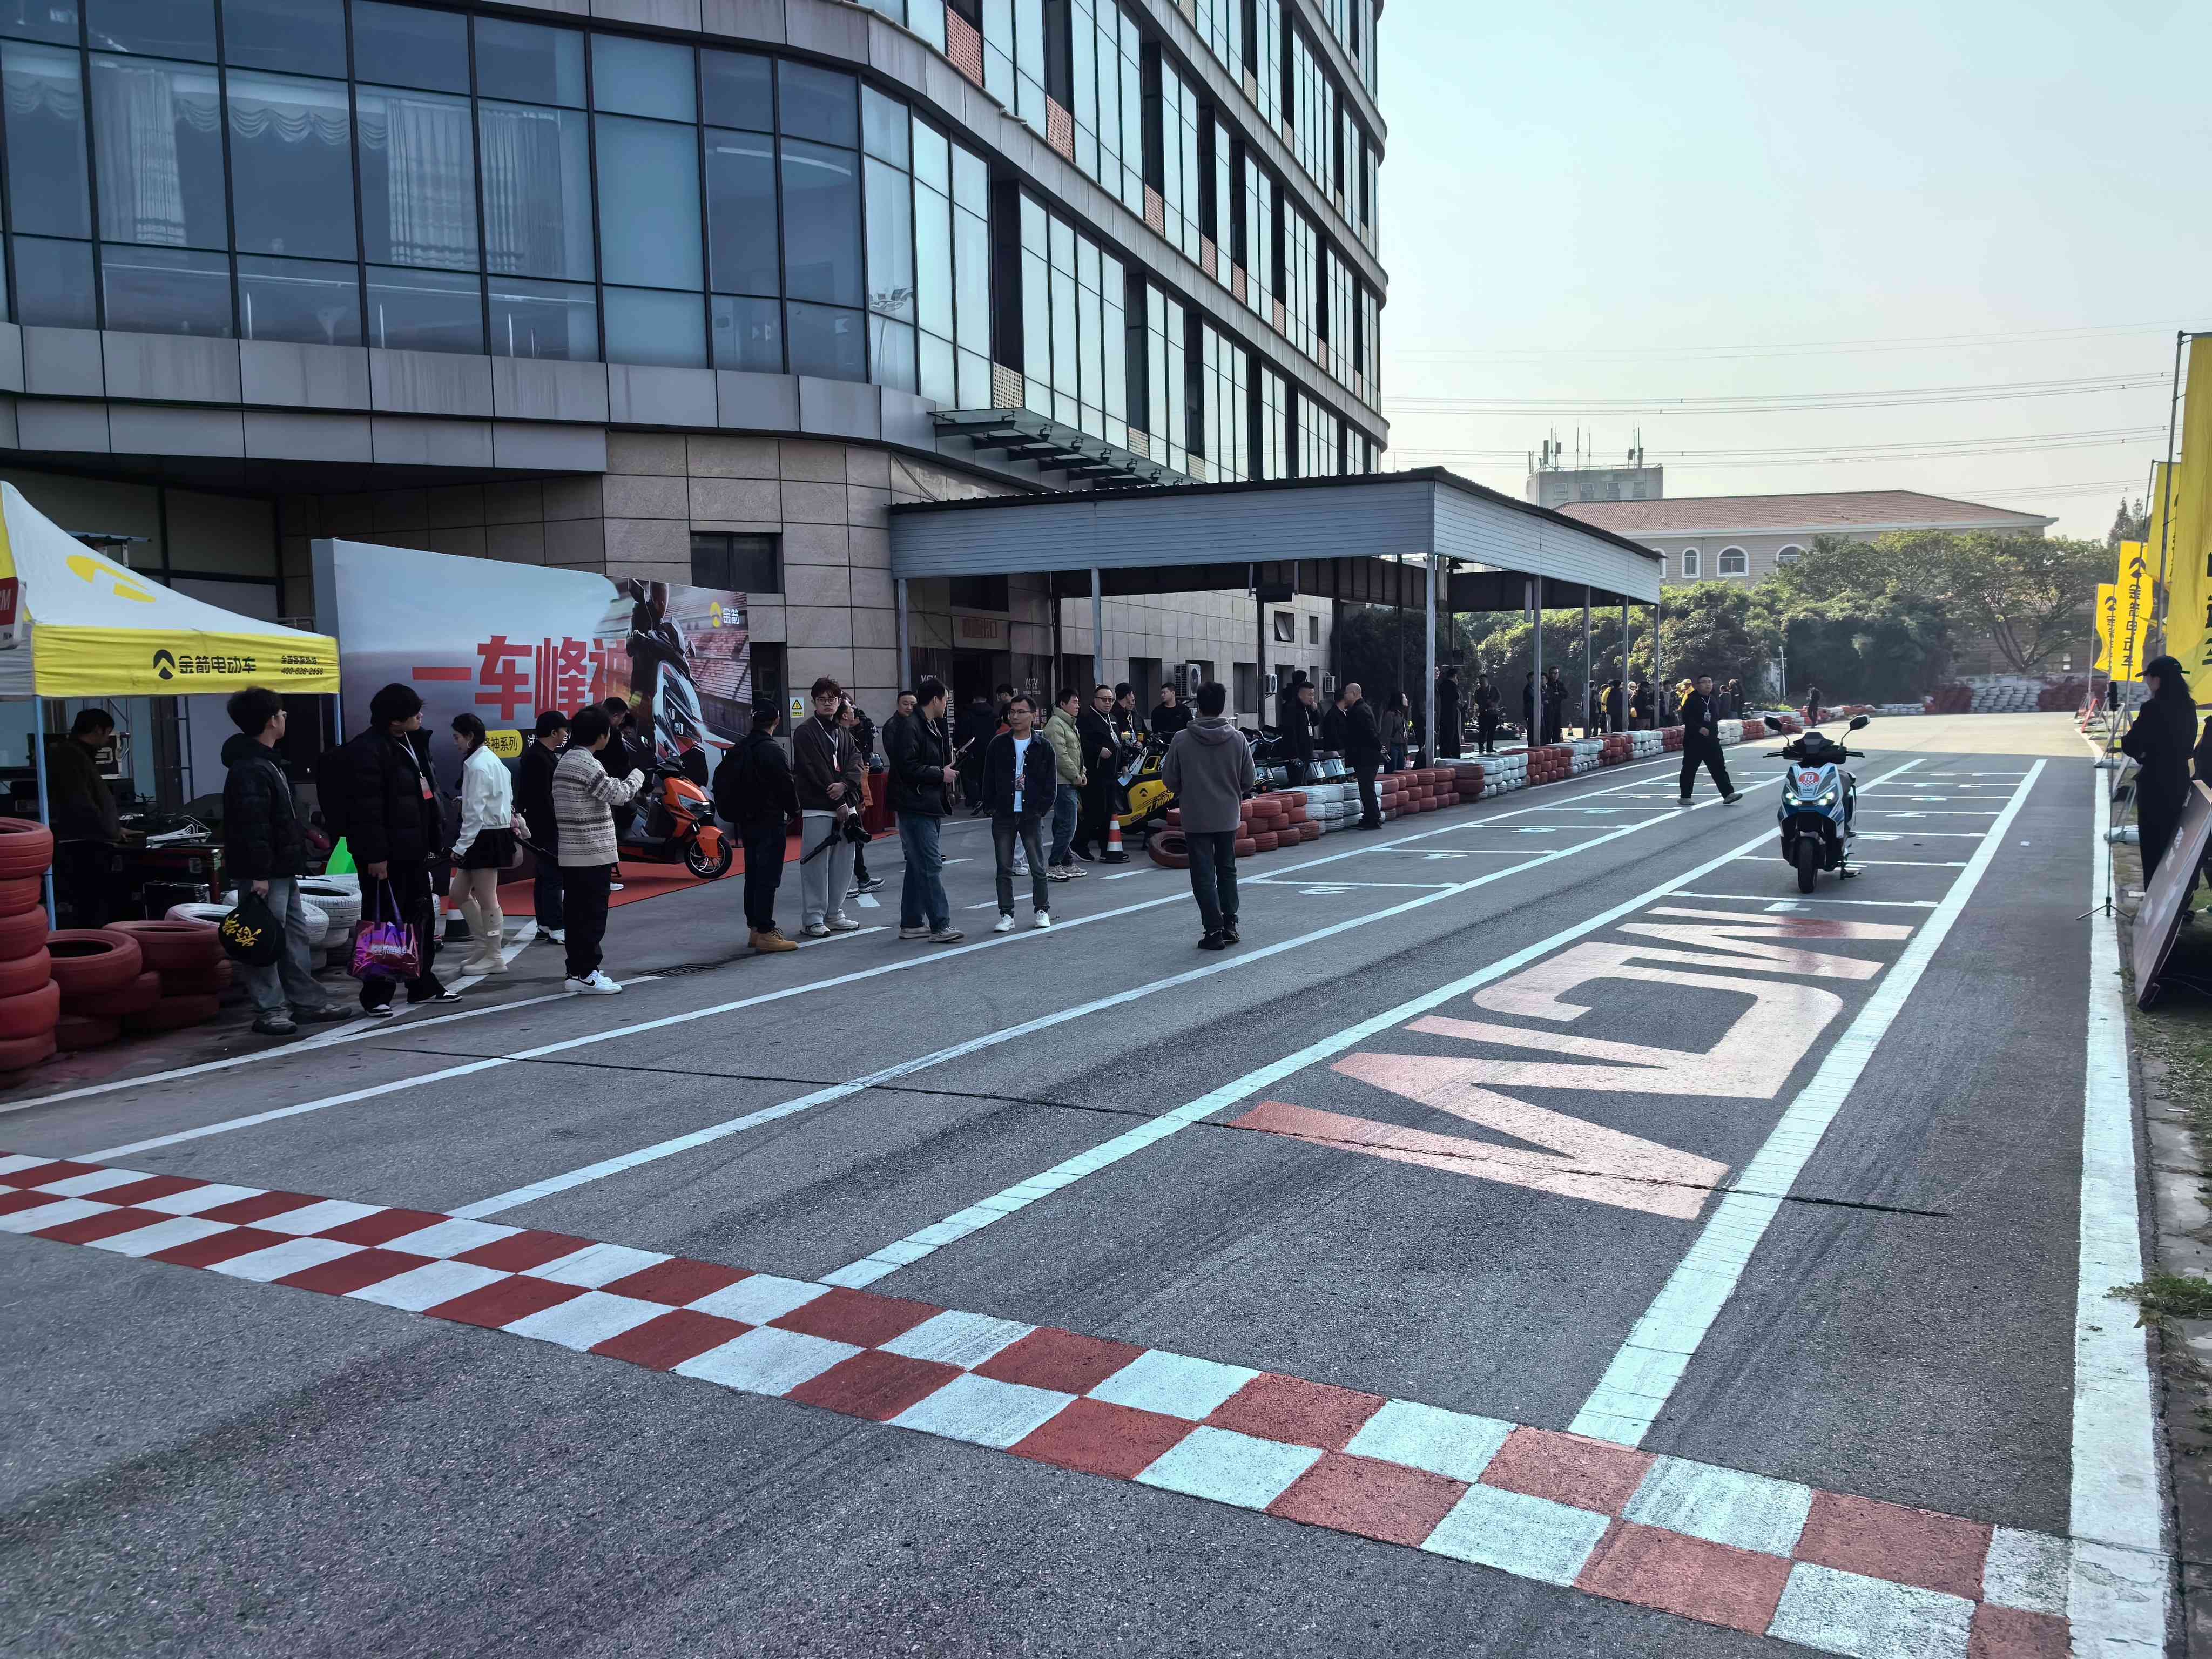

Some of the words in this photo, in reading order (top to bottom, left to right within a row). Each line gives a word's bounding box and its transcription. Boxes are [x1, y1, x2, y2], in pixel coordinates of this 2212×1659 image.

[723, 608, 739, 625] 金箭
[179, 655, 257, 674] 金箭电动车
[1298, 886, 1359, 895] 2
